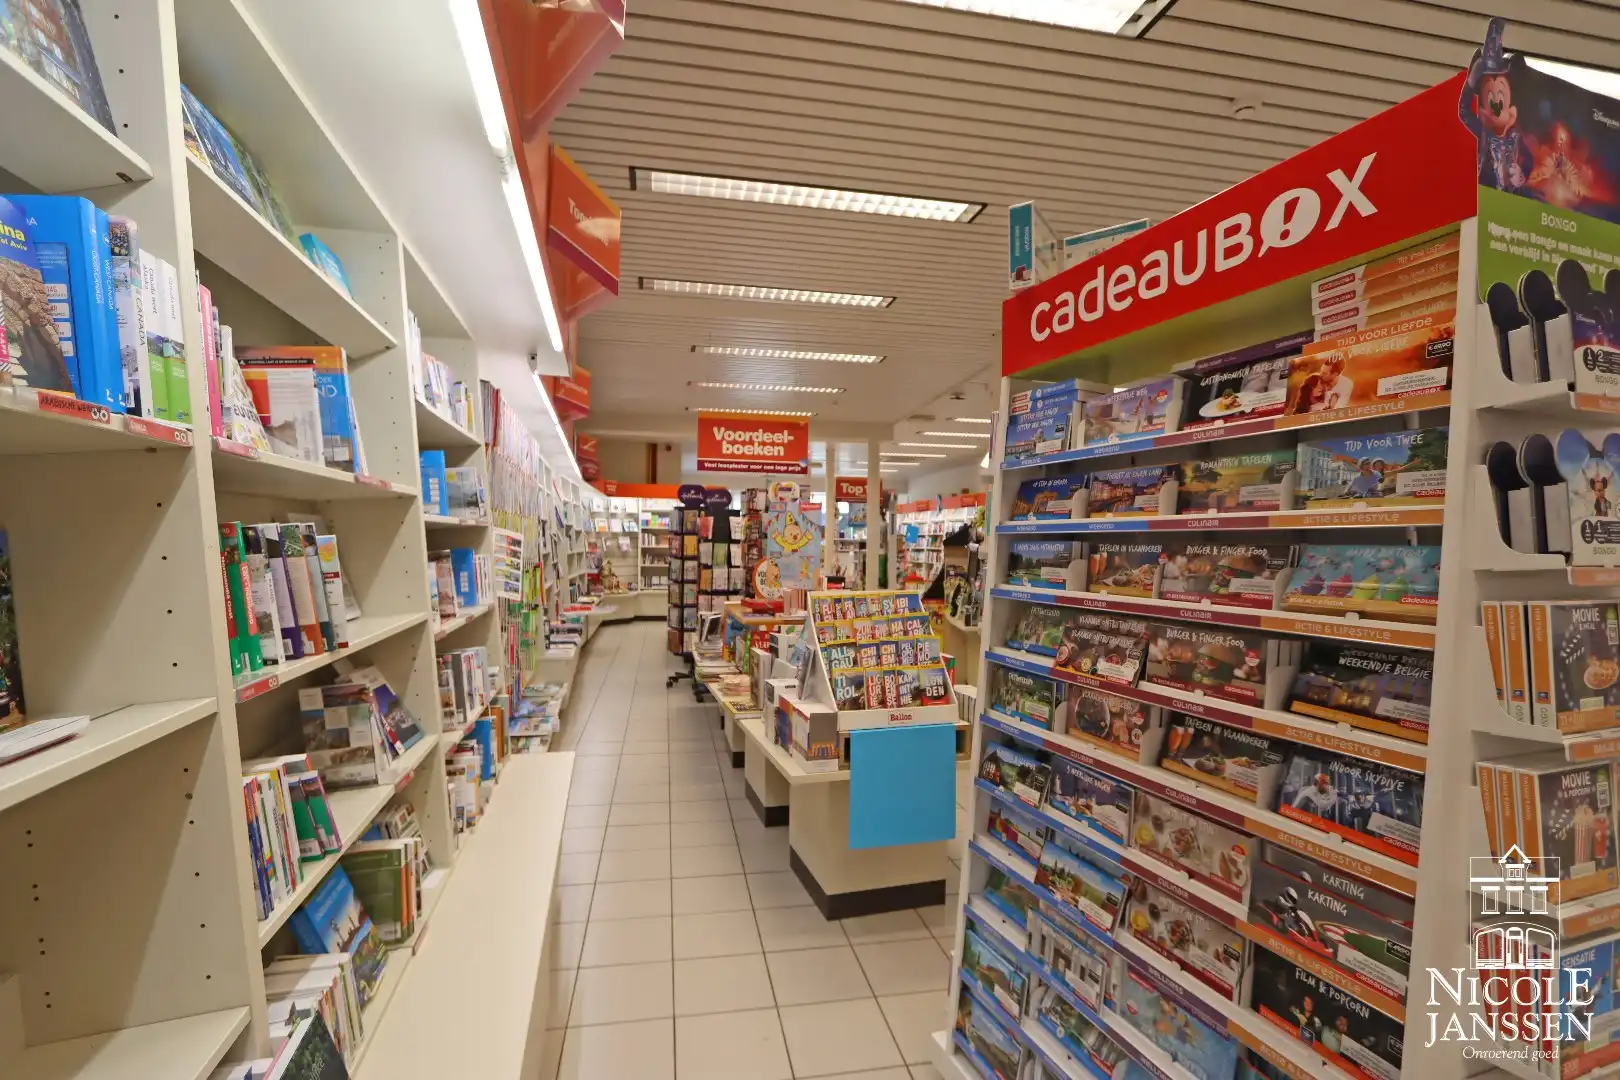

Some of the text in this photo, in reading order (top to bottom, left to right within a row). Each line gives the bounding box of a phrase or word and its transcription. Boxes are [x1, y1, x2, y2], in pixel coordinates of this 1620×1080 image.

[1541, 213, 1577, 233] BONGO
[135, 297, 146, 346] CANADA
[1359, 327, 1389, 341] VOOR
[1200, 358, 1284, 388] GASTRONOMISCH TAFELEN
[713, 427, 795, 443] Voordeel-
[1366, 437, 1393, 450] VOOR
[1396, 433, 1424, 445] TWEE
[722, 442, 785, 457] boeken
[1242, 454, 1273, 466] TAFELEN
[840, 482, 864, 496] Top
[1220, 546, 1248, 556] FINGER
[1248, 546, 1268, 557] FOOD
[1572, 608, 1601, 623] MOVIE
[1198, 632, 1225, 646] FINGER
[1225, 637, 1245, 648] FOOD
[1339, 657, 1392, 673] WEEKENDJE
[836, 687, 859, 700] ROL
[926, 686, 945, 697] DEN
[890, 713, 913, 723] Ballon
[1184, 716, 1270, 750] TAFELEN IN VLAANDEREN
[1329, 761, 1405, 792] INDOOR SKYDIVE
[1561, 772, 1591, 789] MOVIE
[1322, 872, 1365, 899] KARTING
[1307, 888, 1348, 916] KARTING
[1295, 968, 1370, 1019] FILM & POPCORN
